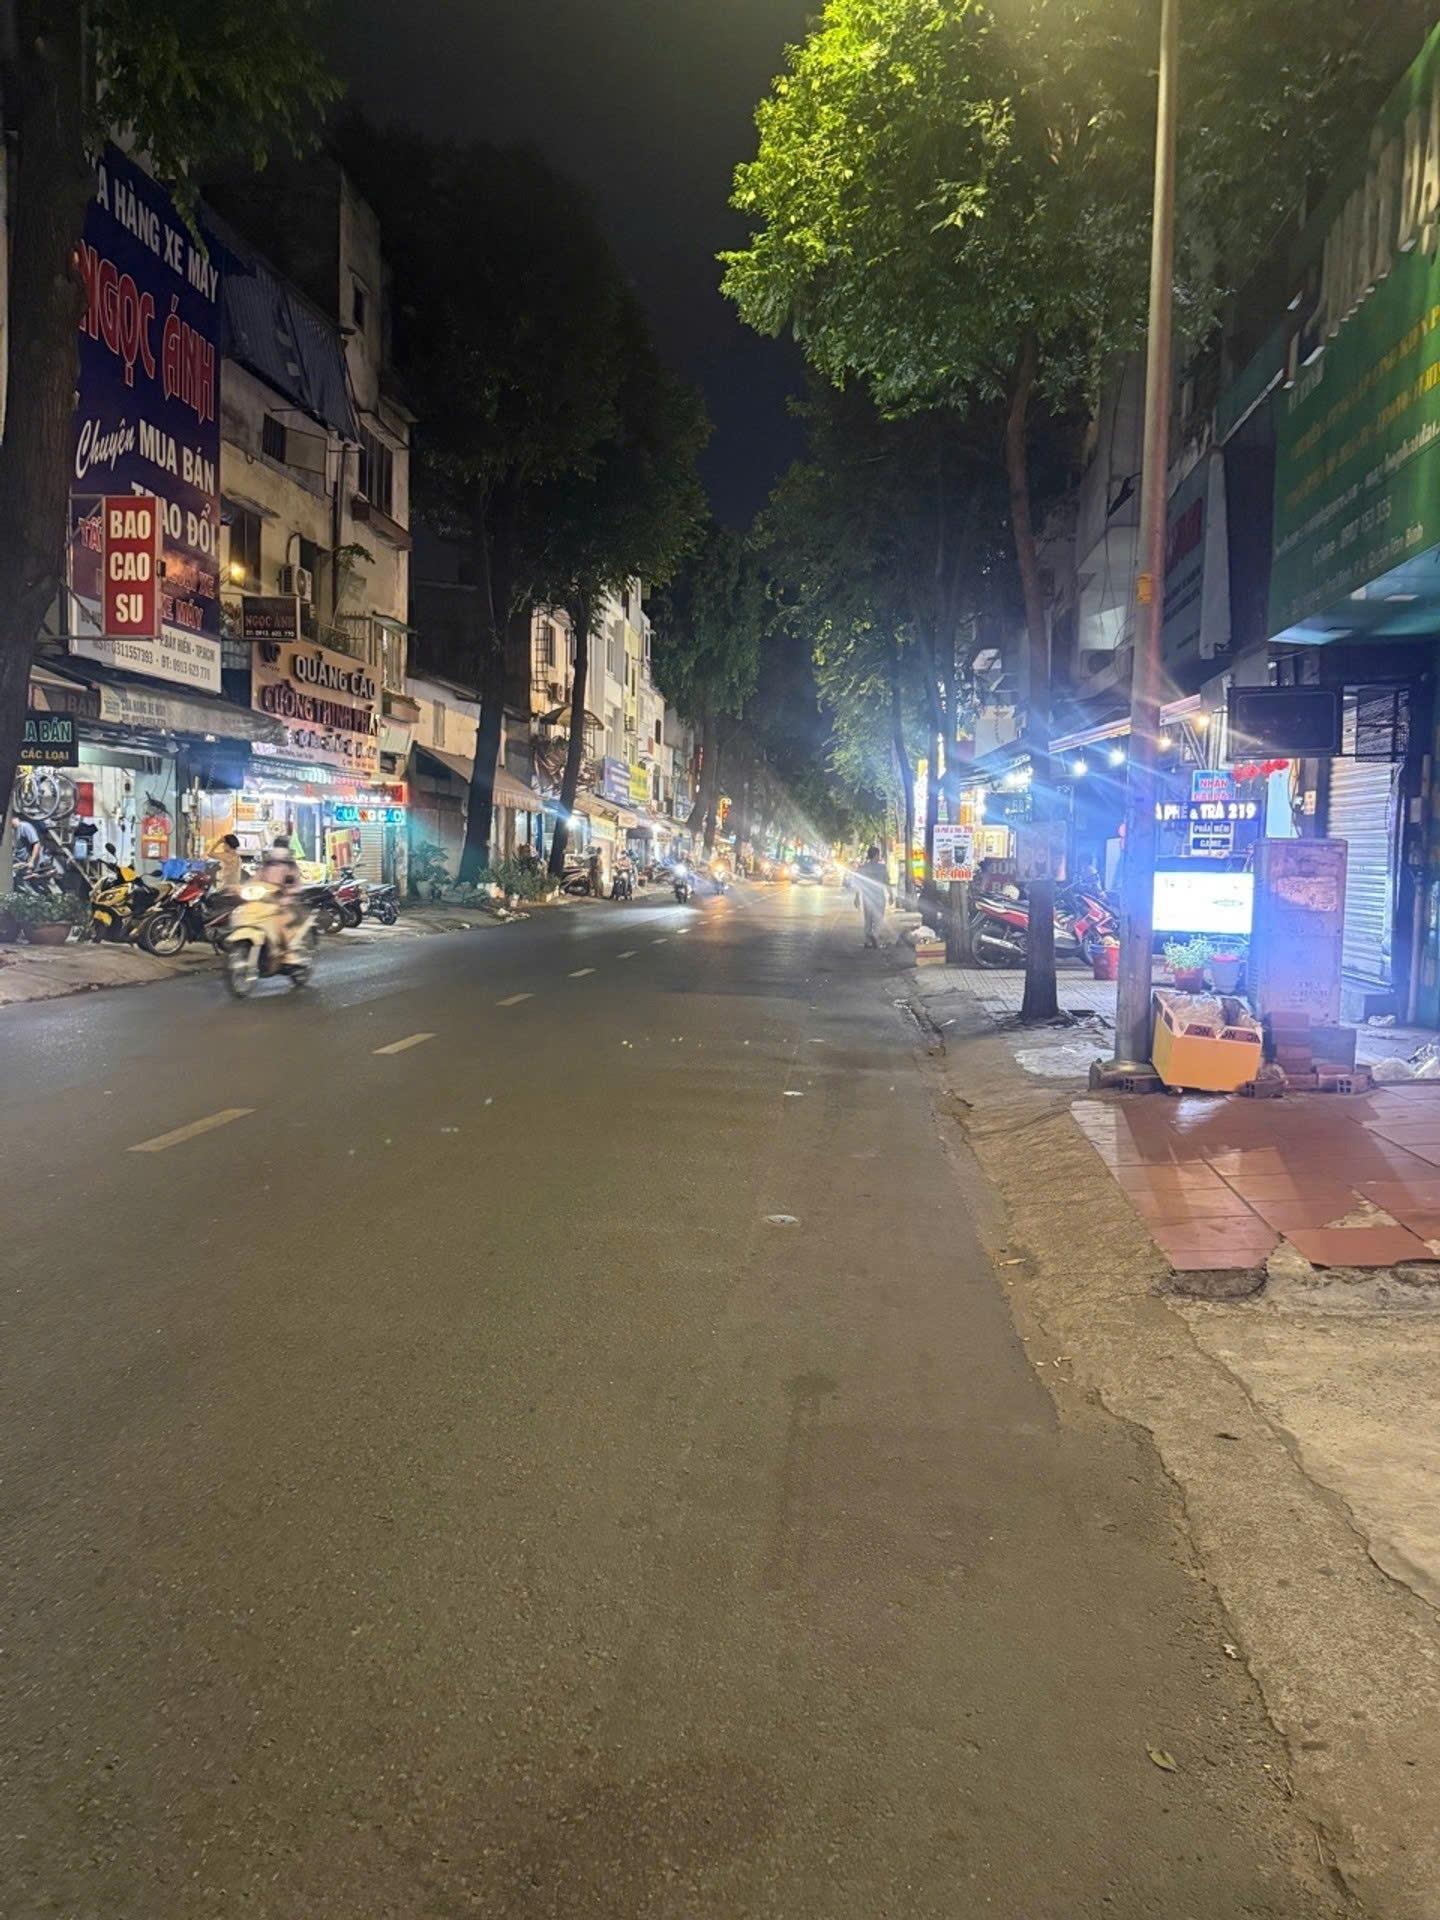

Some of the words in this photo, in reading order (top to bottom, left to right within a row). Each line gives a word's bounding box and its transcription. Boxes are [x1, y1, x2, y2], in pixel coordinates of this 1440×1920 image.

[114, 178, 160, 257] HÀNG
[164, 223, 184, 275] XE
[79, 238, 156, 387] NGỌC
[162, 293, 215, 424] ÁNH
[75, 418, 134, 479] Chuyên
[139, 418, 178, 476] MUA
[182, 446, 215, 497] BÁN
[109, 509, 152, 539] BAO
[187, 502, 216, 556] ĐỔI
[109, 551, 151, 581] CAO
[115, 593, 143, 623] SU
[295, 651, 348, 690] QUẢNG
[349, 668, 375, 699] CÁO
[262, 680, 314, 720] CƯỜNG
[39, 716, 72, 743] BÁN
[21, 747, 43, 760] CÁC
[1190, 808, 1199, 820] &
[1200, 800, 1226, 820] TRÀ
[1228, 802, 1257, 820] 219
